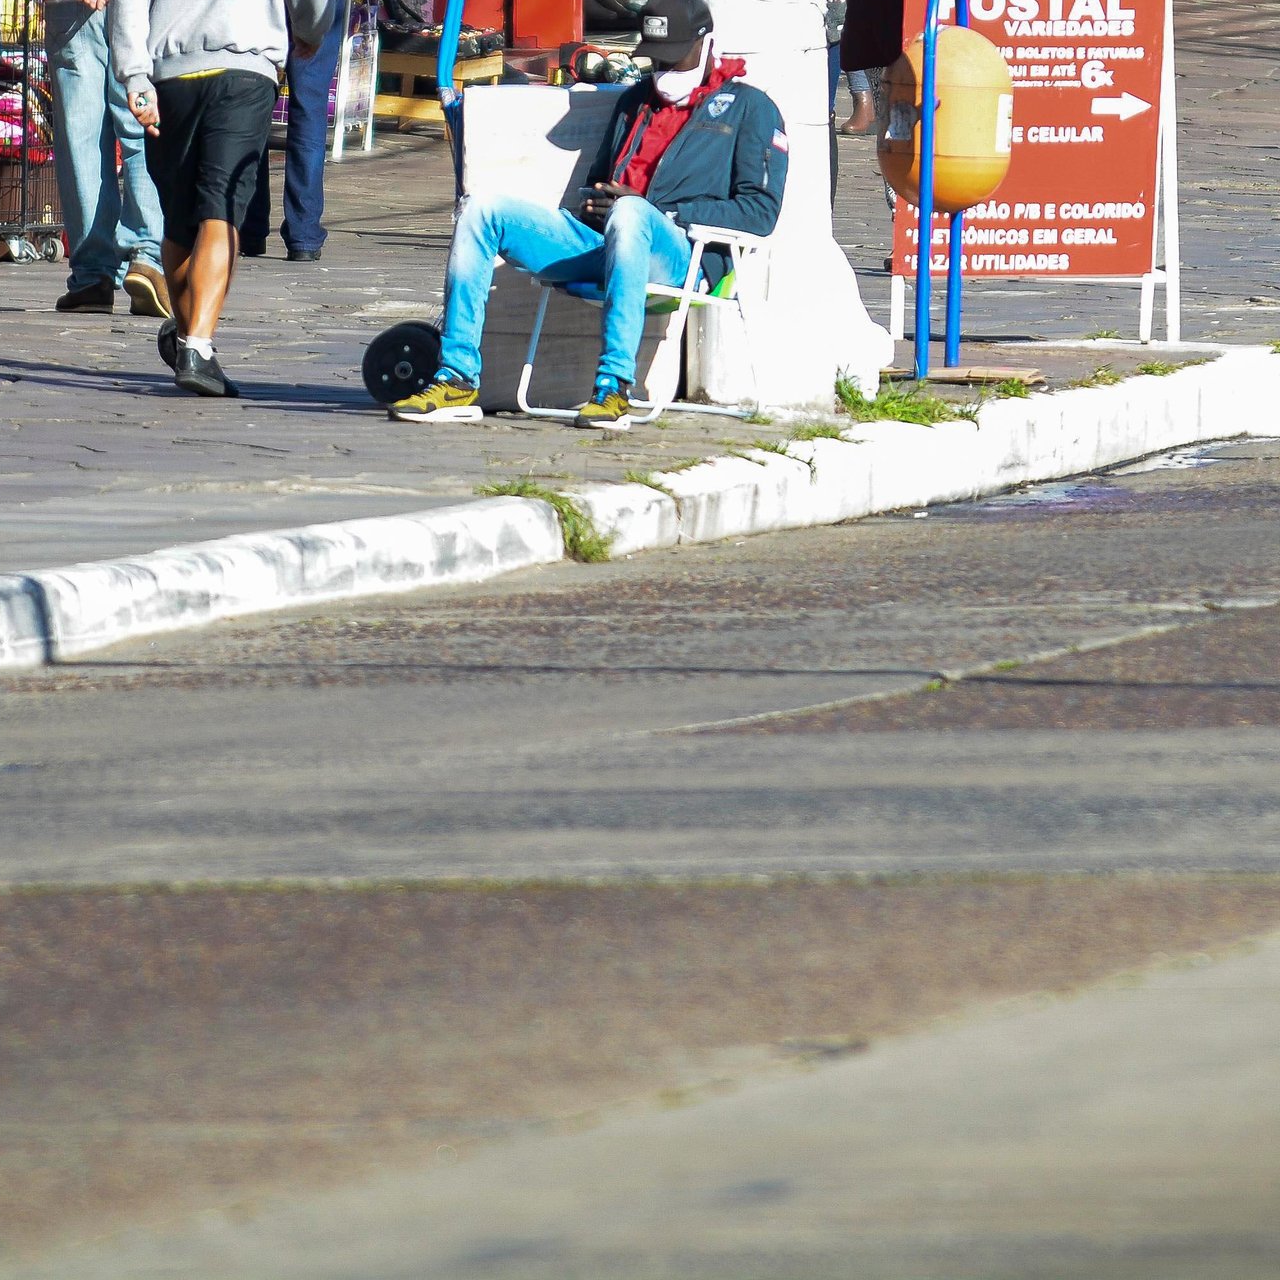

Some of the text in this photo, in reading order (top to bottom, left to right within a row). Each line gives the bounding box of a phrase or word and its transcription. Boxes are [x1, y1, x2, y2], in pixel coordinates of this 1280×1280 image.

[1004, 20, 1136, 37] VARIEDADES
[1016, 46, 1075, 60] BOLETOS
[1076, 46, 1087, 60] E
[1087, 46, 1145, 60] FATURAS
[1030, 64, 1049, 78] EM
[1051, 60, 1077, 78] ATÉ
[1027, 126, 1105, 144] CELULAR
[1013, 202, 1042, 219] P/B
[1043, 203, 1056, 219] E
[1059, 202, 1146, 220] COLORIDO
[1032, 228, 1059, 245] EM
[1060, 228, 1117, 245] GERAL
[971, 253, 1070, 271] UTILIDADES
